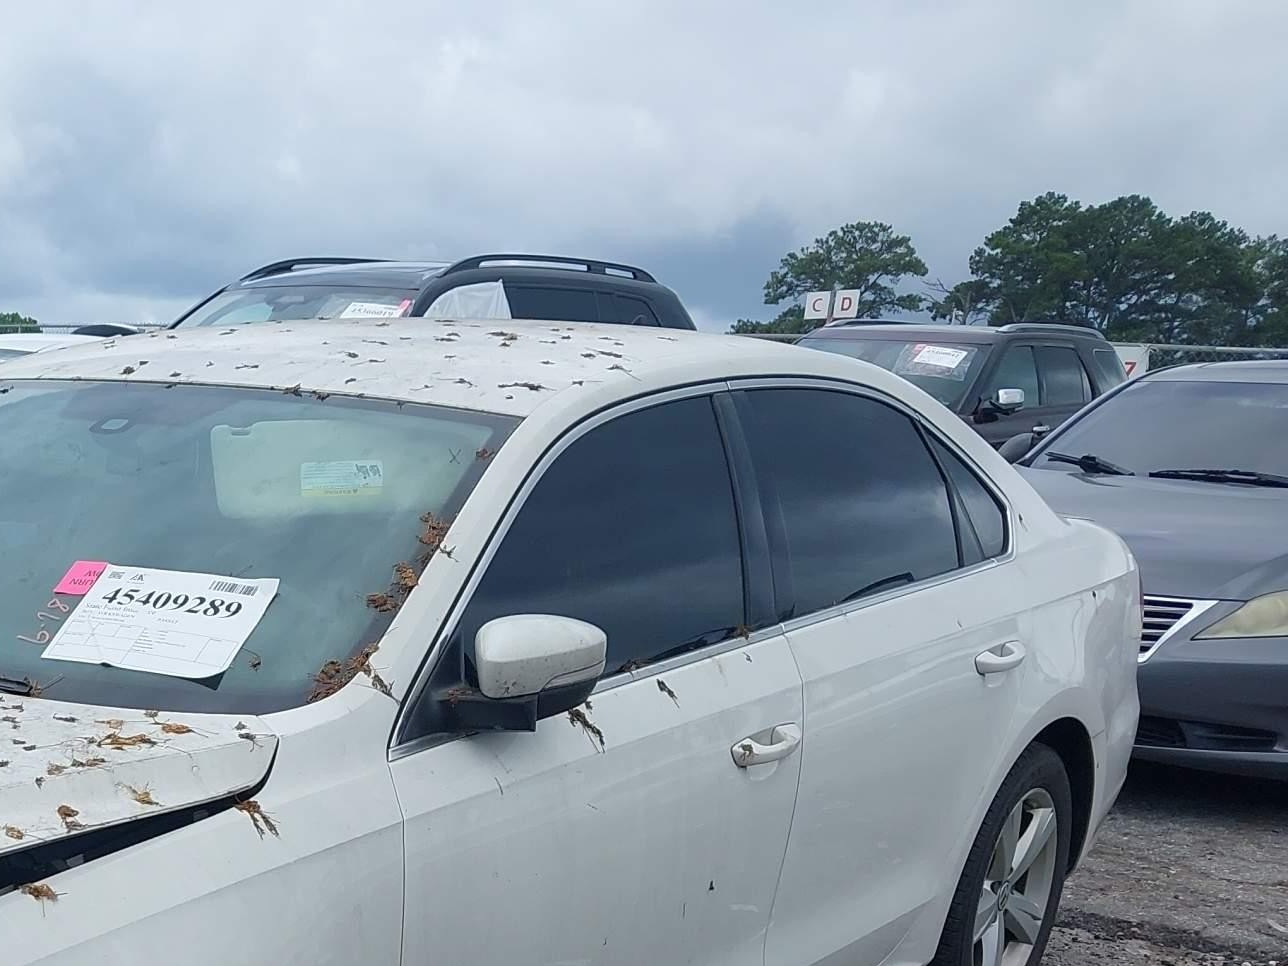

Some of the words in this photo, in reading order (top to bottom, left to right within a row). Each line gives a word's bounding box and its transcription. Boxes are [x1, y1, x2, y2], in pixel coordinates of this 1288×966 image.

[812, 297, 823, 312] C
[840, 296, 852, 311] D
[101, 587, 243, 619] 45409289
